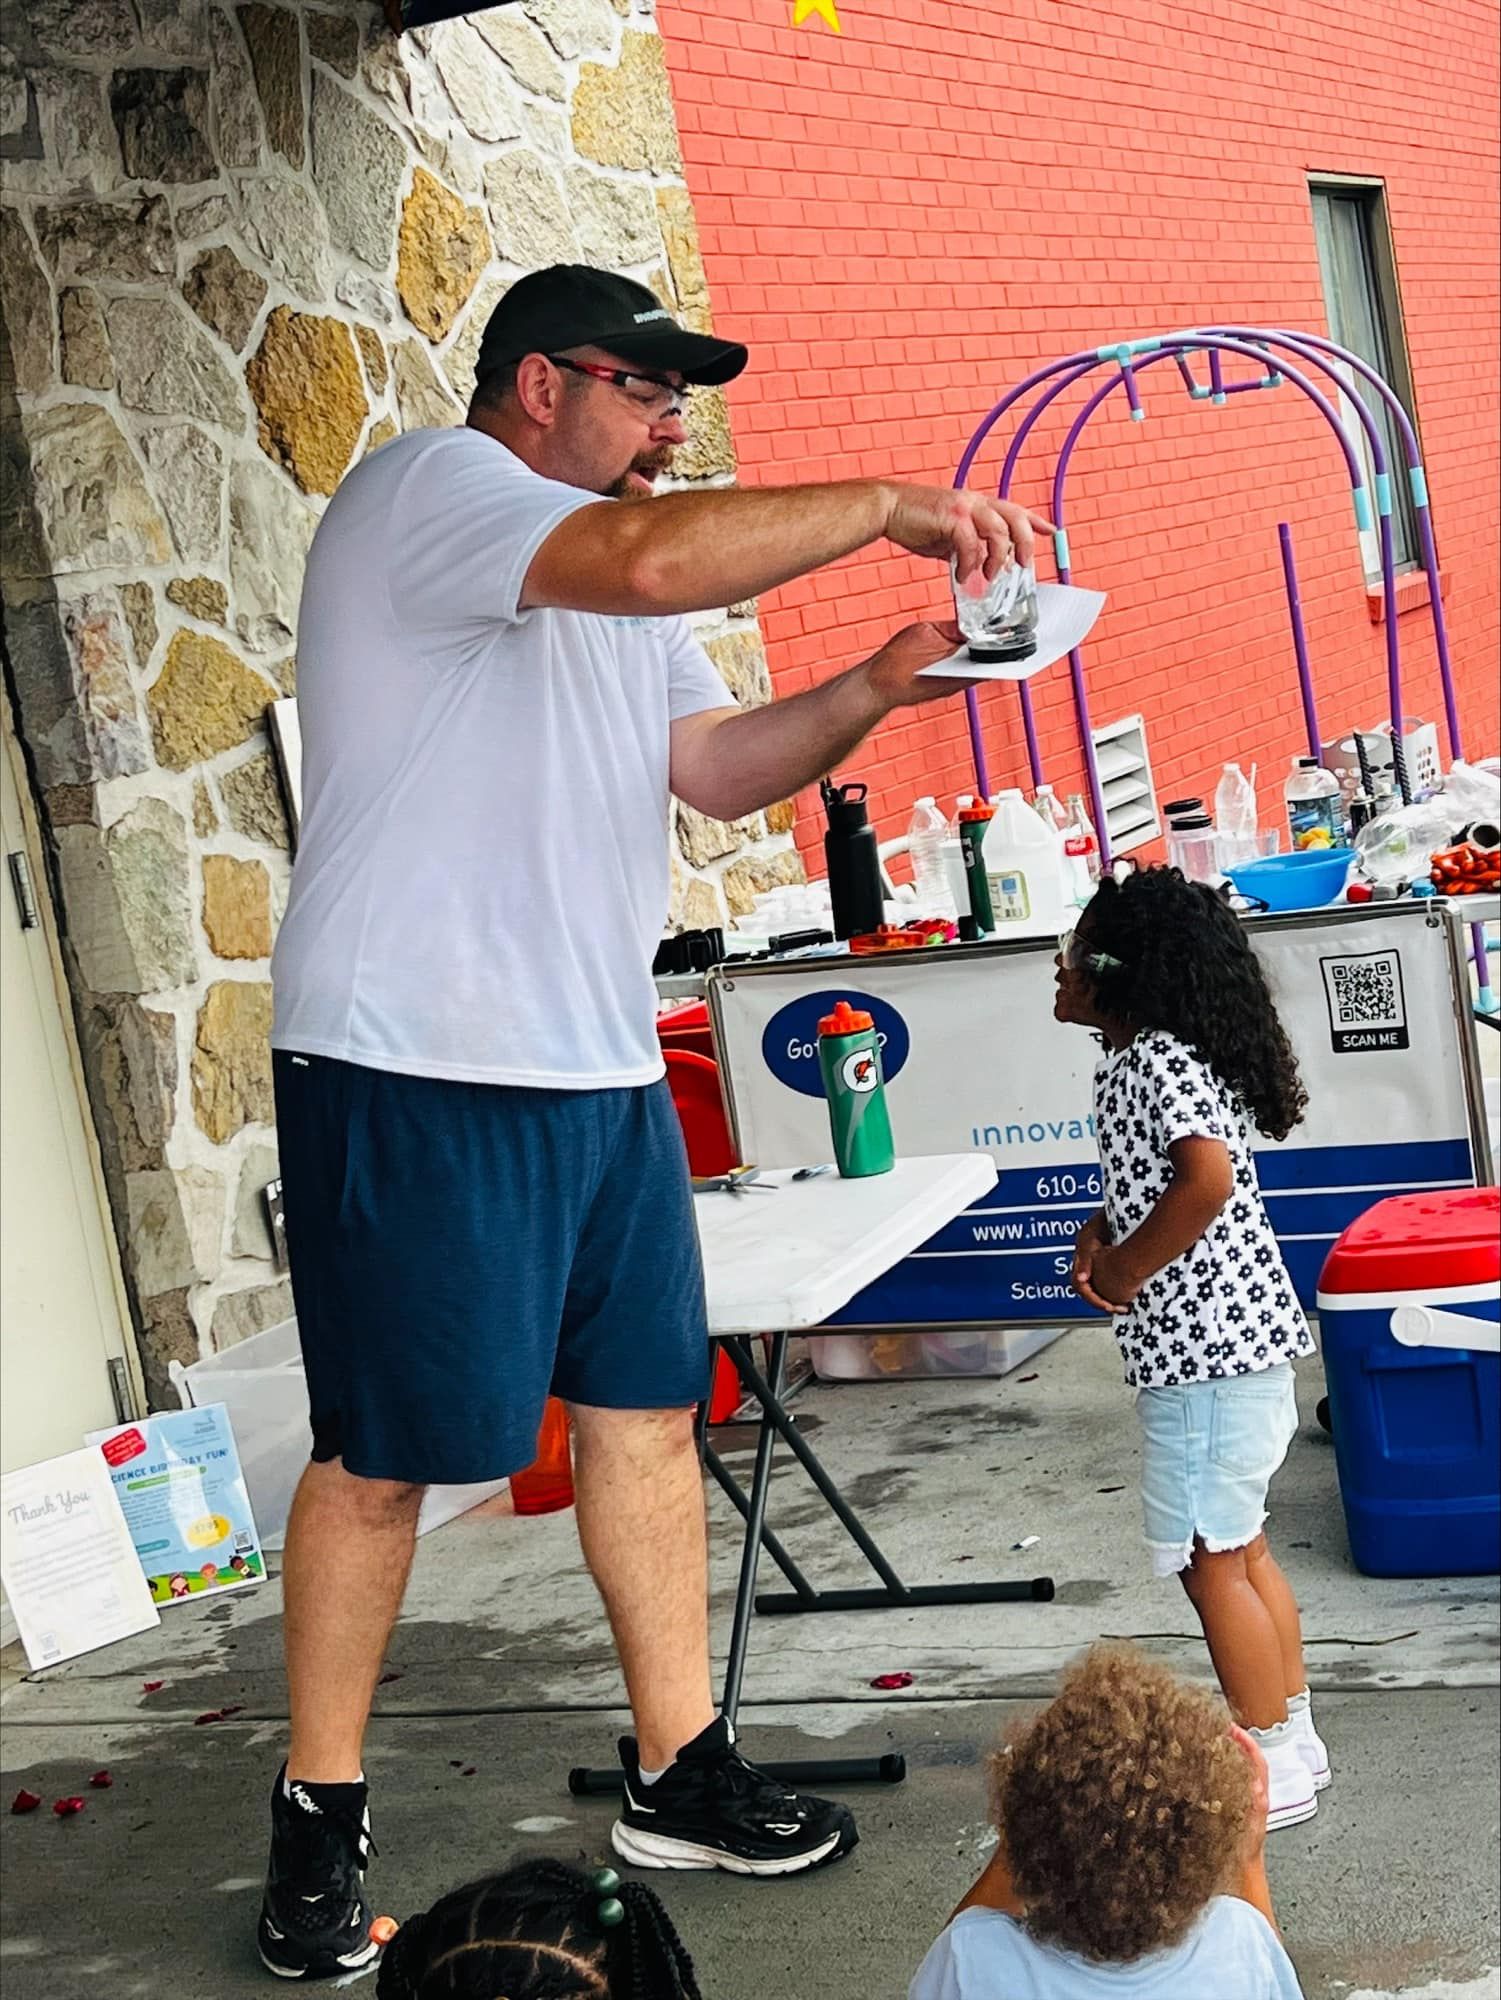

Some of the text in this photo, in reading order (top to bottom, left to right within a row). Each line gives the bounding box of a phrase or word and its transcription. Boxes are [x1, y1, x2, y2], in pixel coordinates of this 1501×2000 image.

[787, 1034, 821, 1059] Got
[1342, 1032, 1399, 1047] SCAN ME
[842, 1048, 878, 1093] G
[1036, 1173, 1100, 1198] 610-6
[1011, 1281, 1082, 1300] Scienc
[8, 1495, 57, 1525] Thank
[56, 1489, 89, 1514] You
